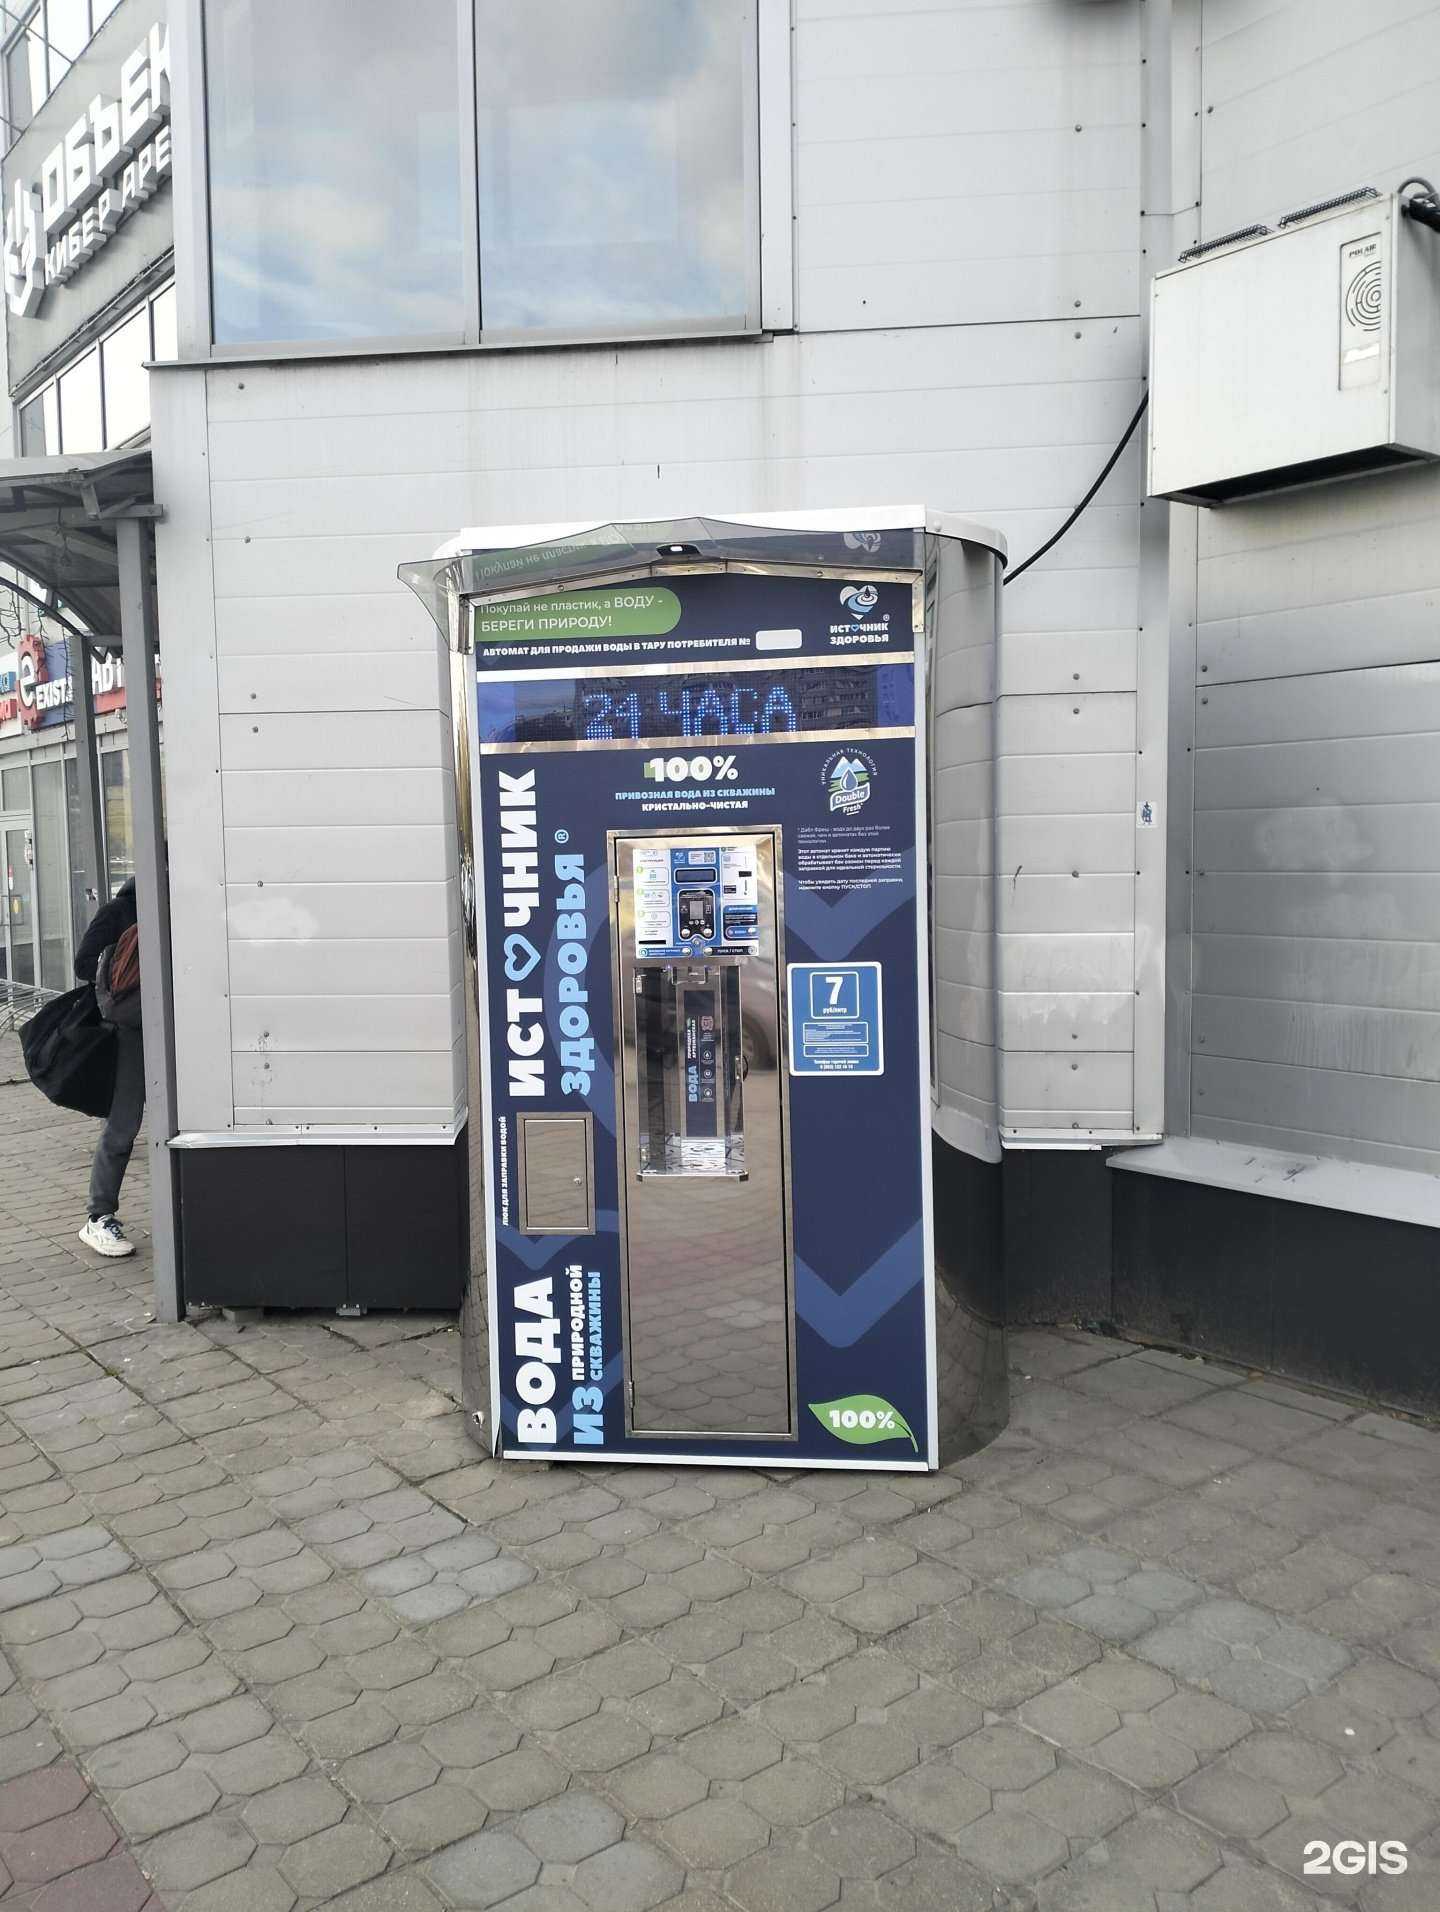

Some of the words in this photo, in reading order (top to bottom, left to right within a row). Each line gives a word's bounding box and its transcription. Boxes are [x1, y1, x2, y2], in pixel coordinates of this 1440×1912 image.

[533, 603, 549, 612] не
[551, 599, 602, 612] пластик,
[604, 600, 612, 609] а
[614, 595, 655, 610] ВОДУ
[481, 618, 534, 632] БЕРЕГИ
[538, 615, 612, 630] ПРИРОДУ!
[483, 646, 529, 657] АВТОМАТ
[531, 645, 551, 656] ДЛЯ
[552, 643, 602, 655] ПРОДАЖИ
[604, 642, 633, 652] ВОДЫ
[634, 642, 641, 650] В
[642, 640, 666, 650] ТАРУ
[667, 637, 737, 649] ПОТРЕБИТЕЛЯ
[738, 636, 751, 646] №
[830, 634, 889, 646] ЗДОРОВЬЯ
[659, 686, 797, 736] ЧАСА
[649, 755, 739, 782] 100%
[615, 790, 673, 801] ПРИВОЗНАЯ
[674, 789, 702, 800] ВОДА
[703, 788, 716, 798] ИЗ
[717, 787, 776, 798] СКВАЖИНЫ
[641, 800, 749, 812] КРИСТАЛЬНО-ЧИСТАЯ
[835, 790, 865, 804] Double
[554, 853, 596, 1097] ЗДОРОВЬЯ
[825, 976, 844, 1005] 7
[687, 1065, 699, 1102] ВОДА
[498, 1116, 508, 1145] ВОДОЙ
[500, 1145, 508, 1188] ЗАПРАВКИ
[565, 1264, 585, 1381] ПРИРОДНОЙ
[587, 1271, 604, 1381] СКВАЖИНЫ
[513, 1276, 562, 1444] ВОДА
[572, 1386, 605, 1445] ИЗ
[829, 1409, 896, 1429] 100%
